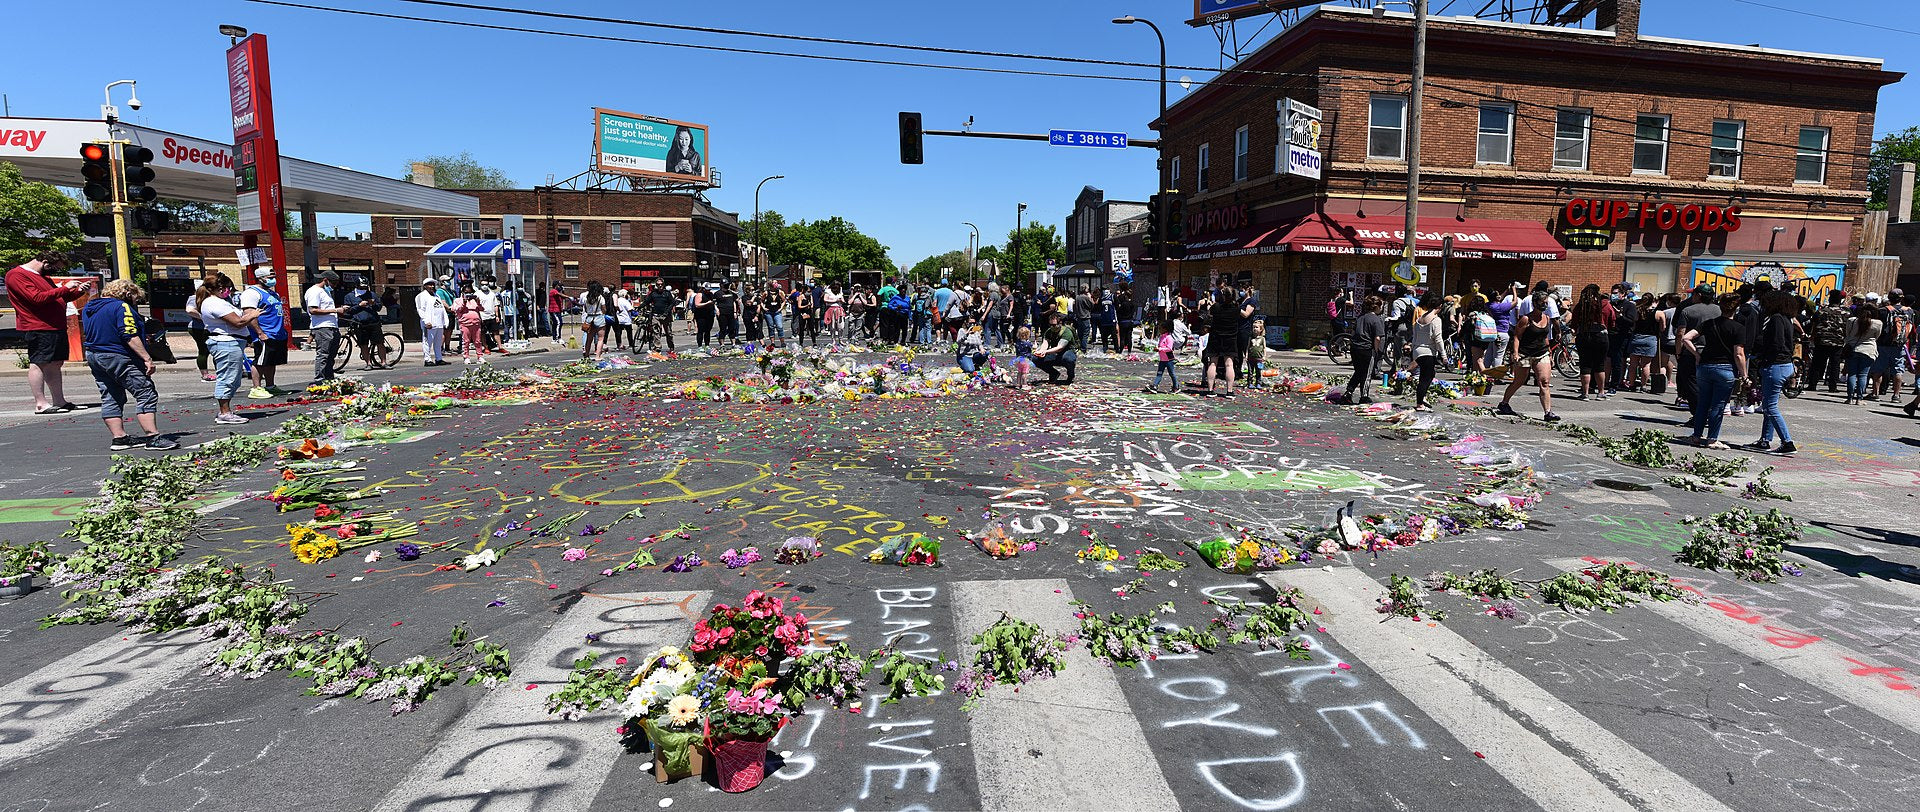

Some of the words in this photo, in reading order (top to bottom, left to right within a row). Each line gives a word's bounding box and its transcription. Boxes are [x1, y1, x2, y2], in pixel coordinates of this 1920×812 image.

[604, 118, 633, 129] Screen
[635, 122, 653, 132] time
[604, 127, 620, 136] just
[622, 130, 636, 138] got
[638, 131, 668, 142] healthy.
[604, 136, 628, 144] Introducing
[1067, 134, 1074, 143] E
[1080, 134, 1108, 145] 38th
[1112, 136, 1124, 145] St
[604, 154, 636, 165] NORTH
[1291, 150, 1320, 170] metro
[1206, 204, 1248, 231] FOODS
[1566, 198, 1630, 228] CUP
[1638, 202, 1742, 232] FOODS
[1356, 230, 1390, 240] Hot
[1454, 232, 1492, 242] Deli
[1260, 245, 1274, 254] HALAL
[1274, 244, 1288, 252] MEAT
[1338, 246, 1377, 254] EASTERN
[1492, 251, 1518, 259] FRESH
[1113, 260, 1127, 269] 25
[502, 295, 510, 306] 10
[976, 485, 1069, 534] SAY
[859, 689, 943, 812] LIVE
